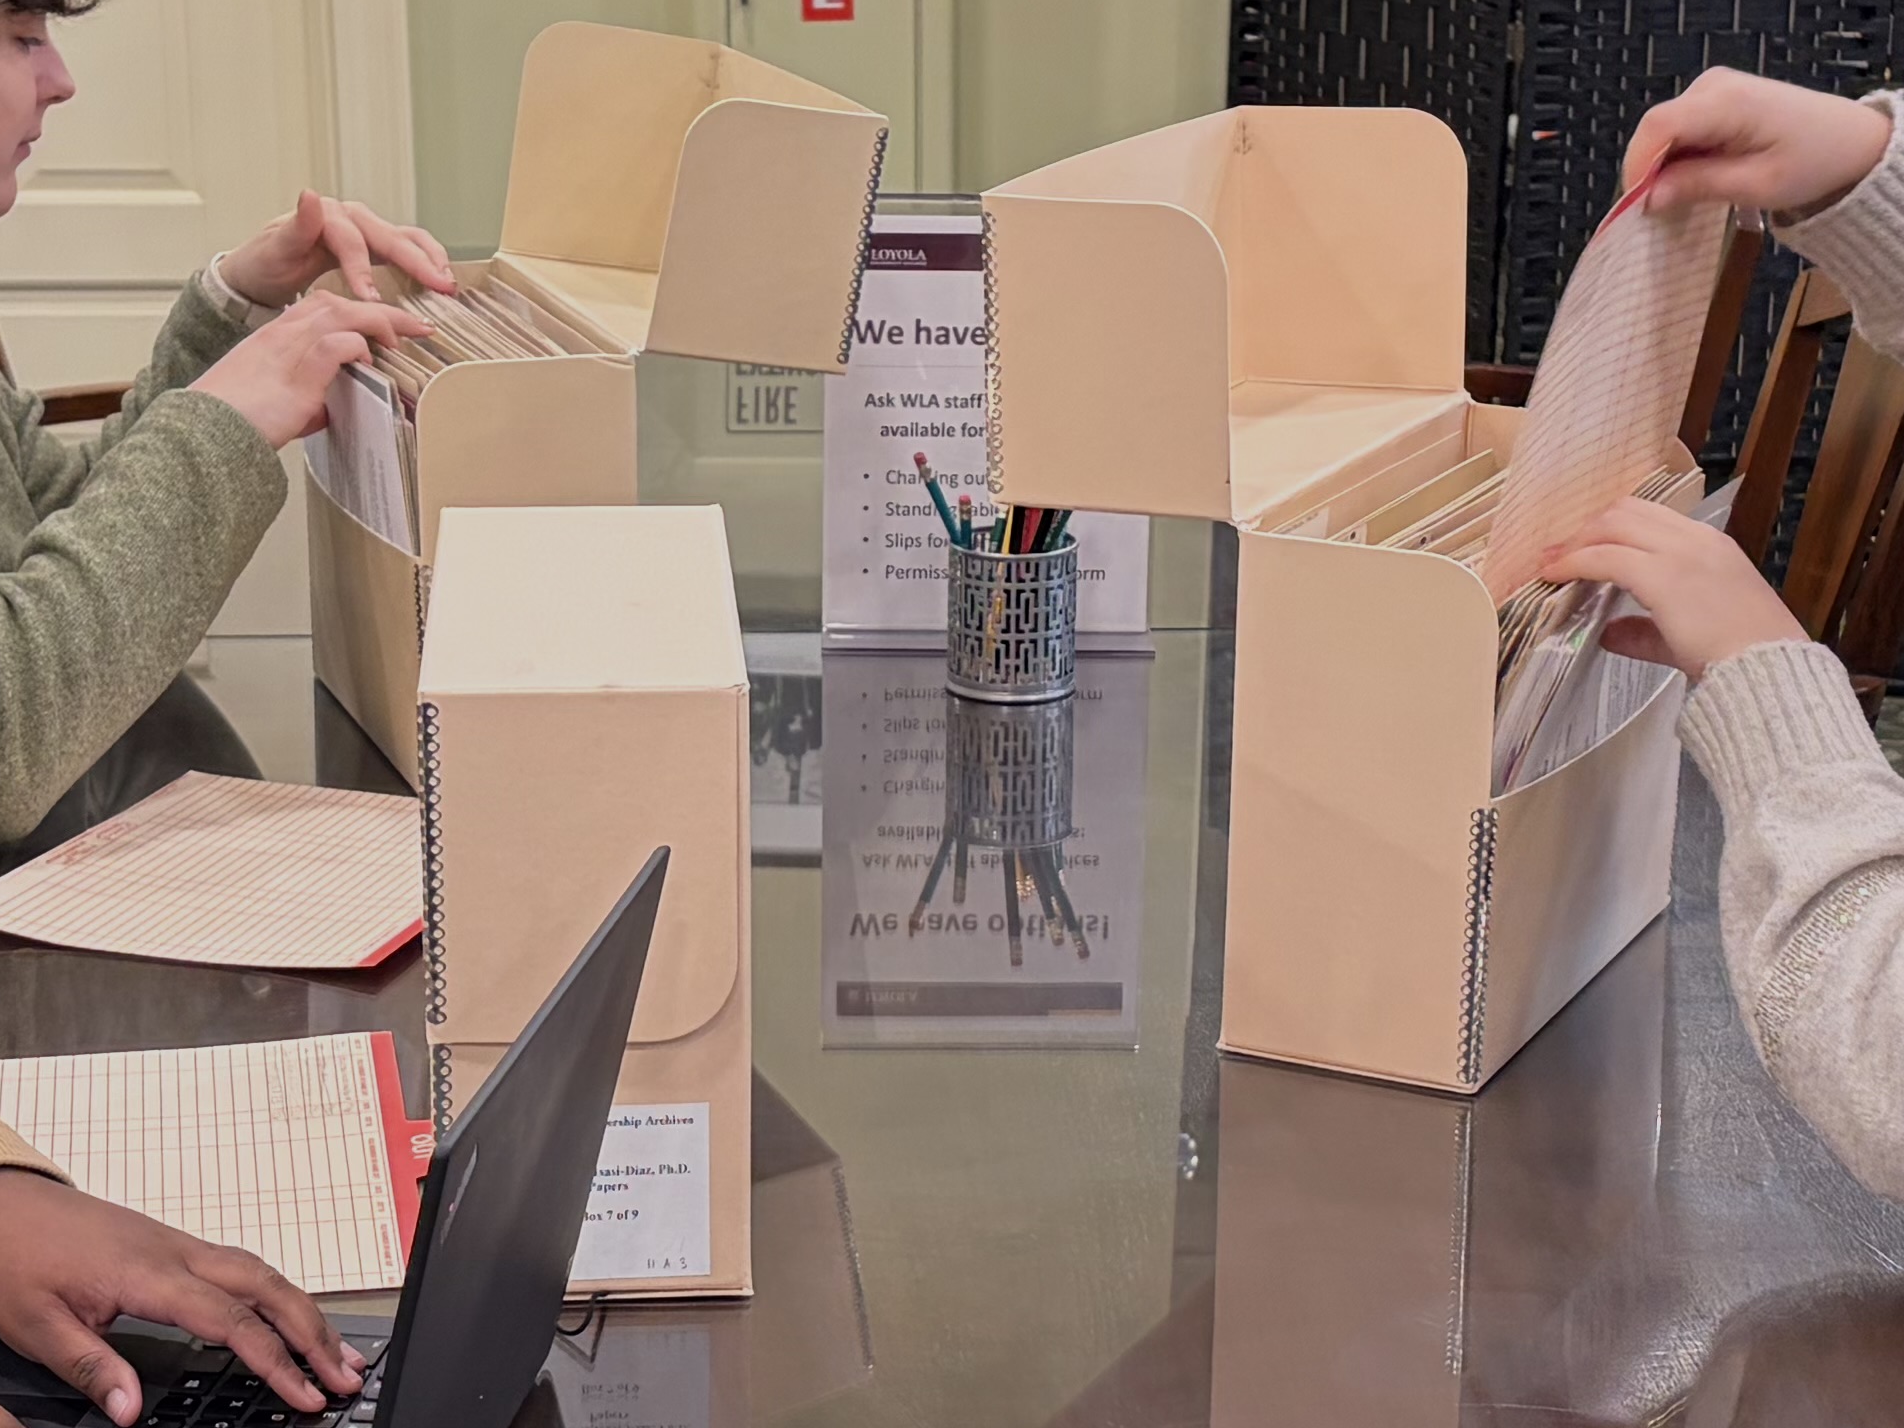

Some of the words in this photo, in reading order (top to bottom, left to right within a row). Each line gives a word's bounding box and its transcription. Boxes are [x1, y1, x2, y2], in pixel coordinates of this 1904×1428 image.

[871, 248, 927, 261] LOYOLA
[853, 319, 904, 345] We
[914, 318, 988, 345] have
[864, 392, 895, 408] Ask
[900, 393, 940, 408] WLA
[944, 393, 984, 409] staff
[880, 422, 956, 438] available
[960, 422, 985, 438] for
[885, 533, 922, 551] Slips
[885, 564, 949, 580] Permiss
[1075, 569, 1106, 581] orm
[607, 1116, 642, 1130] ership
[645, 1114, 694, 1127] Archives
[658, 1163, 691, 1175] Ph.D.
[607, 1210, 613, 1221] 7
[616, 1209, 629, 1221] of
[632, 1209, 639, 1220] 9
